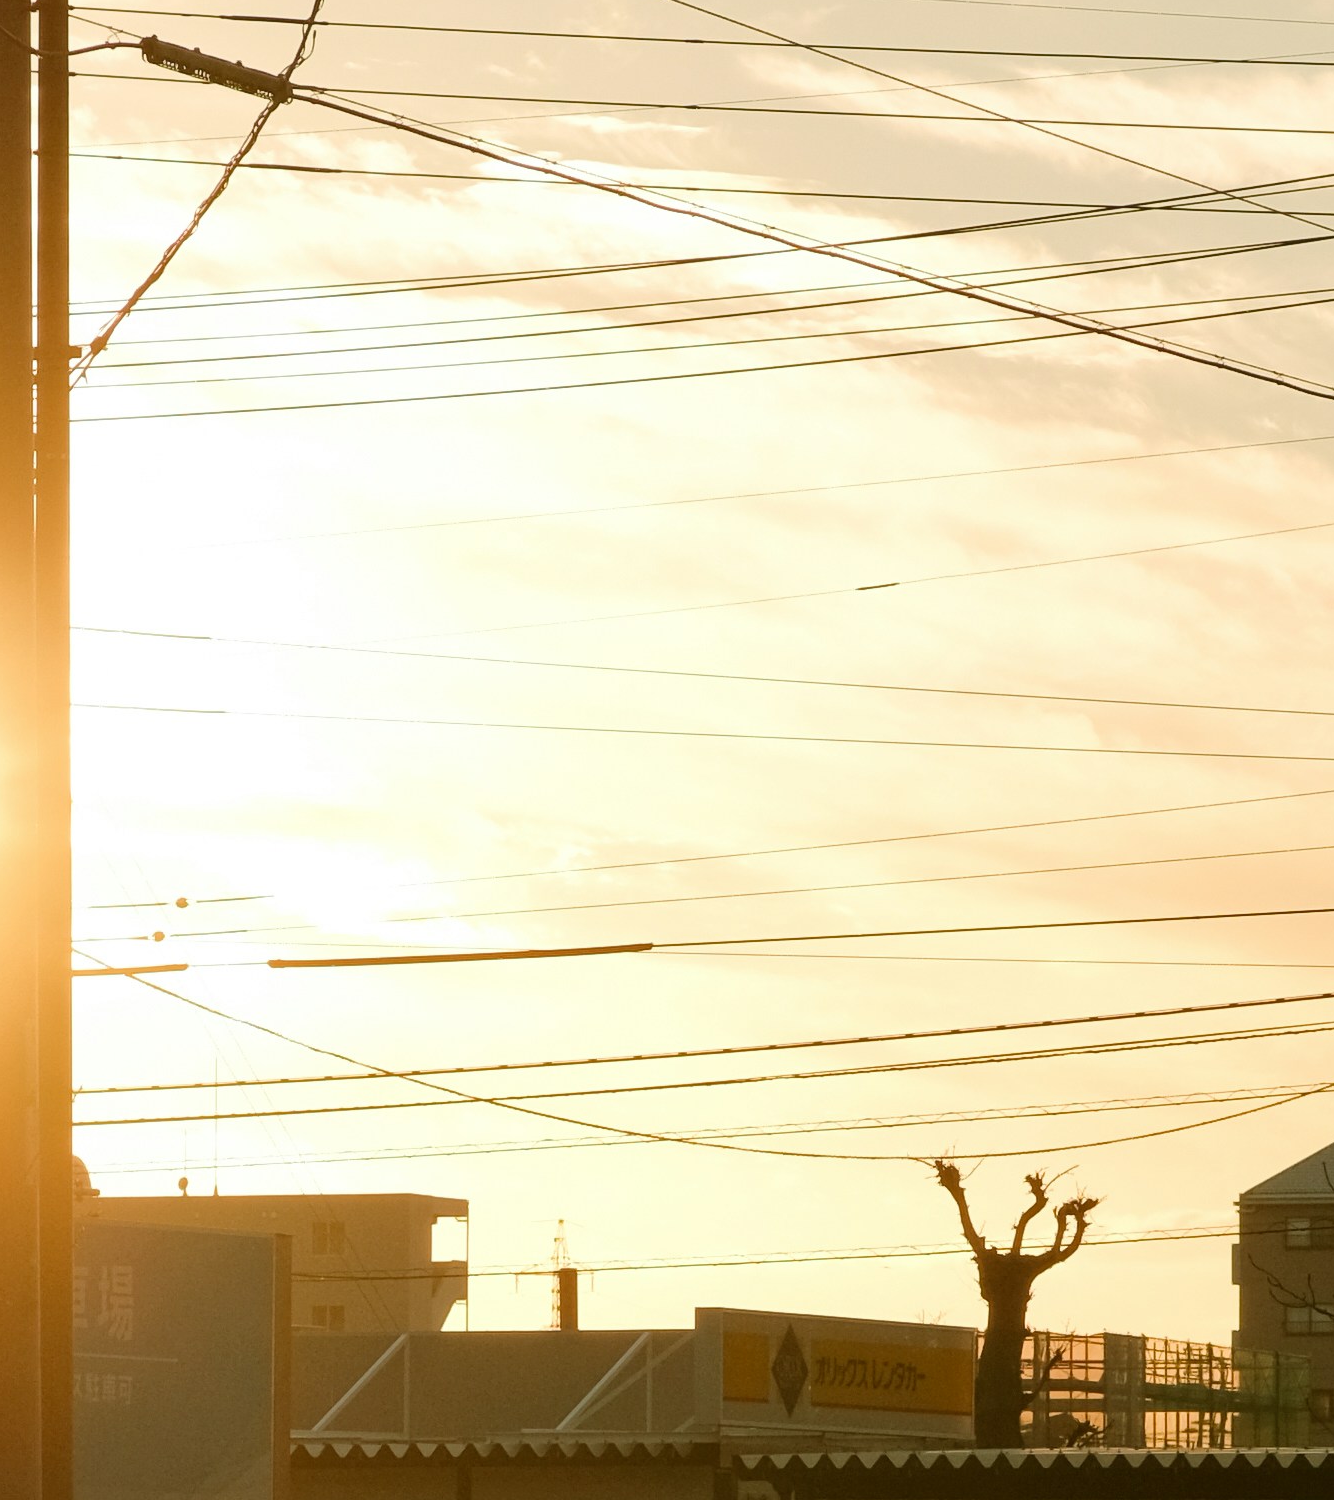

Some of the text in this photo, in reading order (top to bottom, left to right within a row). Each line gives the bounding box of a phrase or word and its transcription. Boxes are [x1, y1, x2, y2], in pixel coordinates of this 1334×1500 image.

[815, 1356, 926, 1392] オリックスレンタカー
